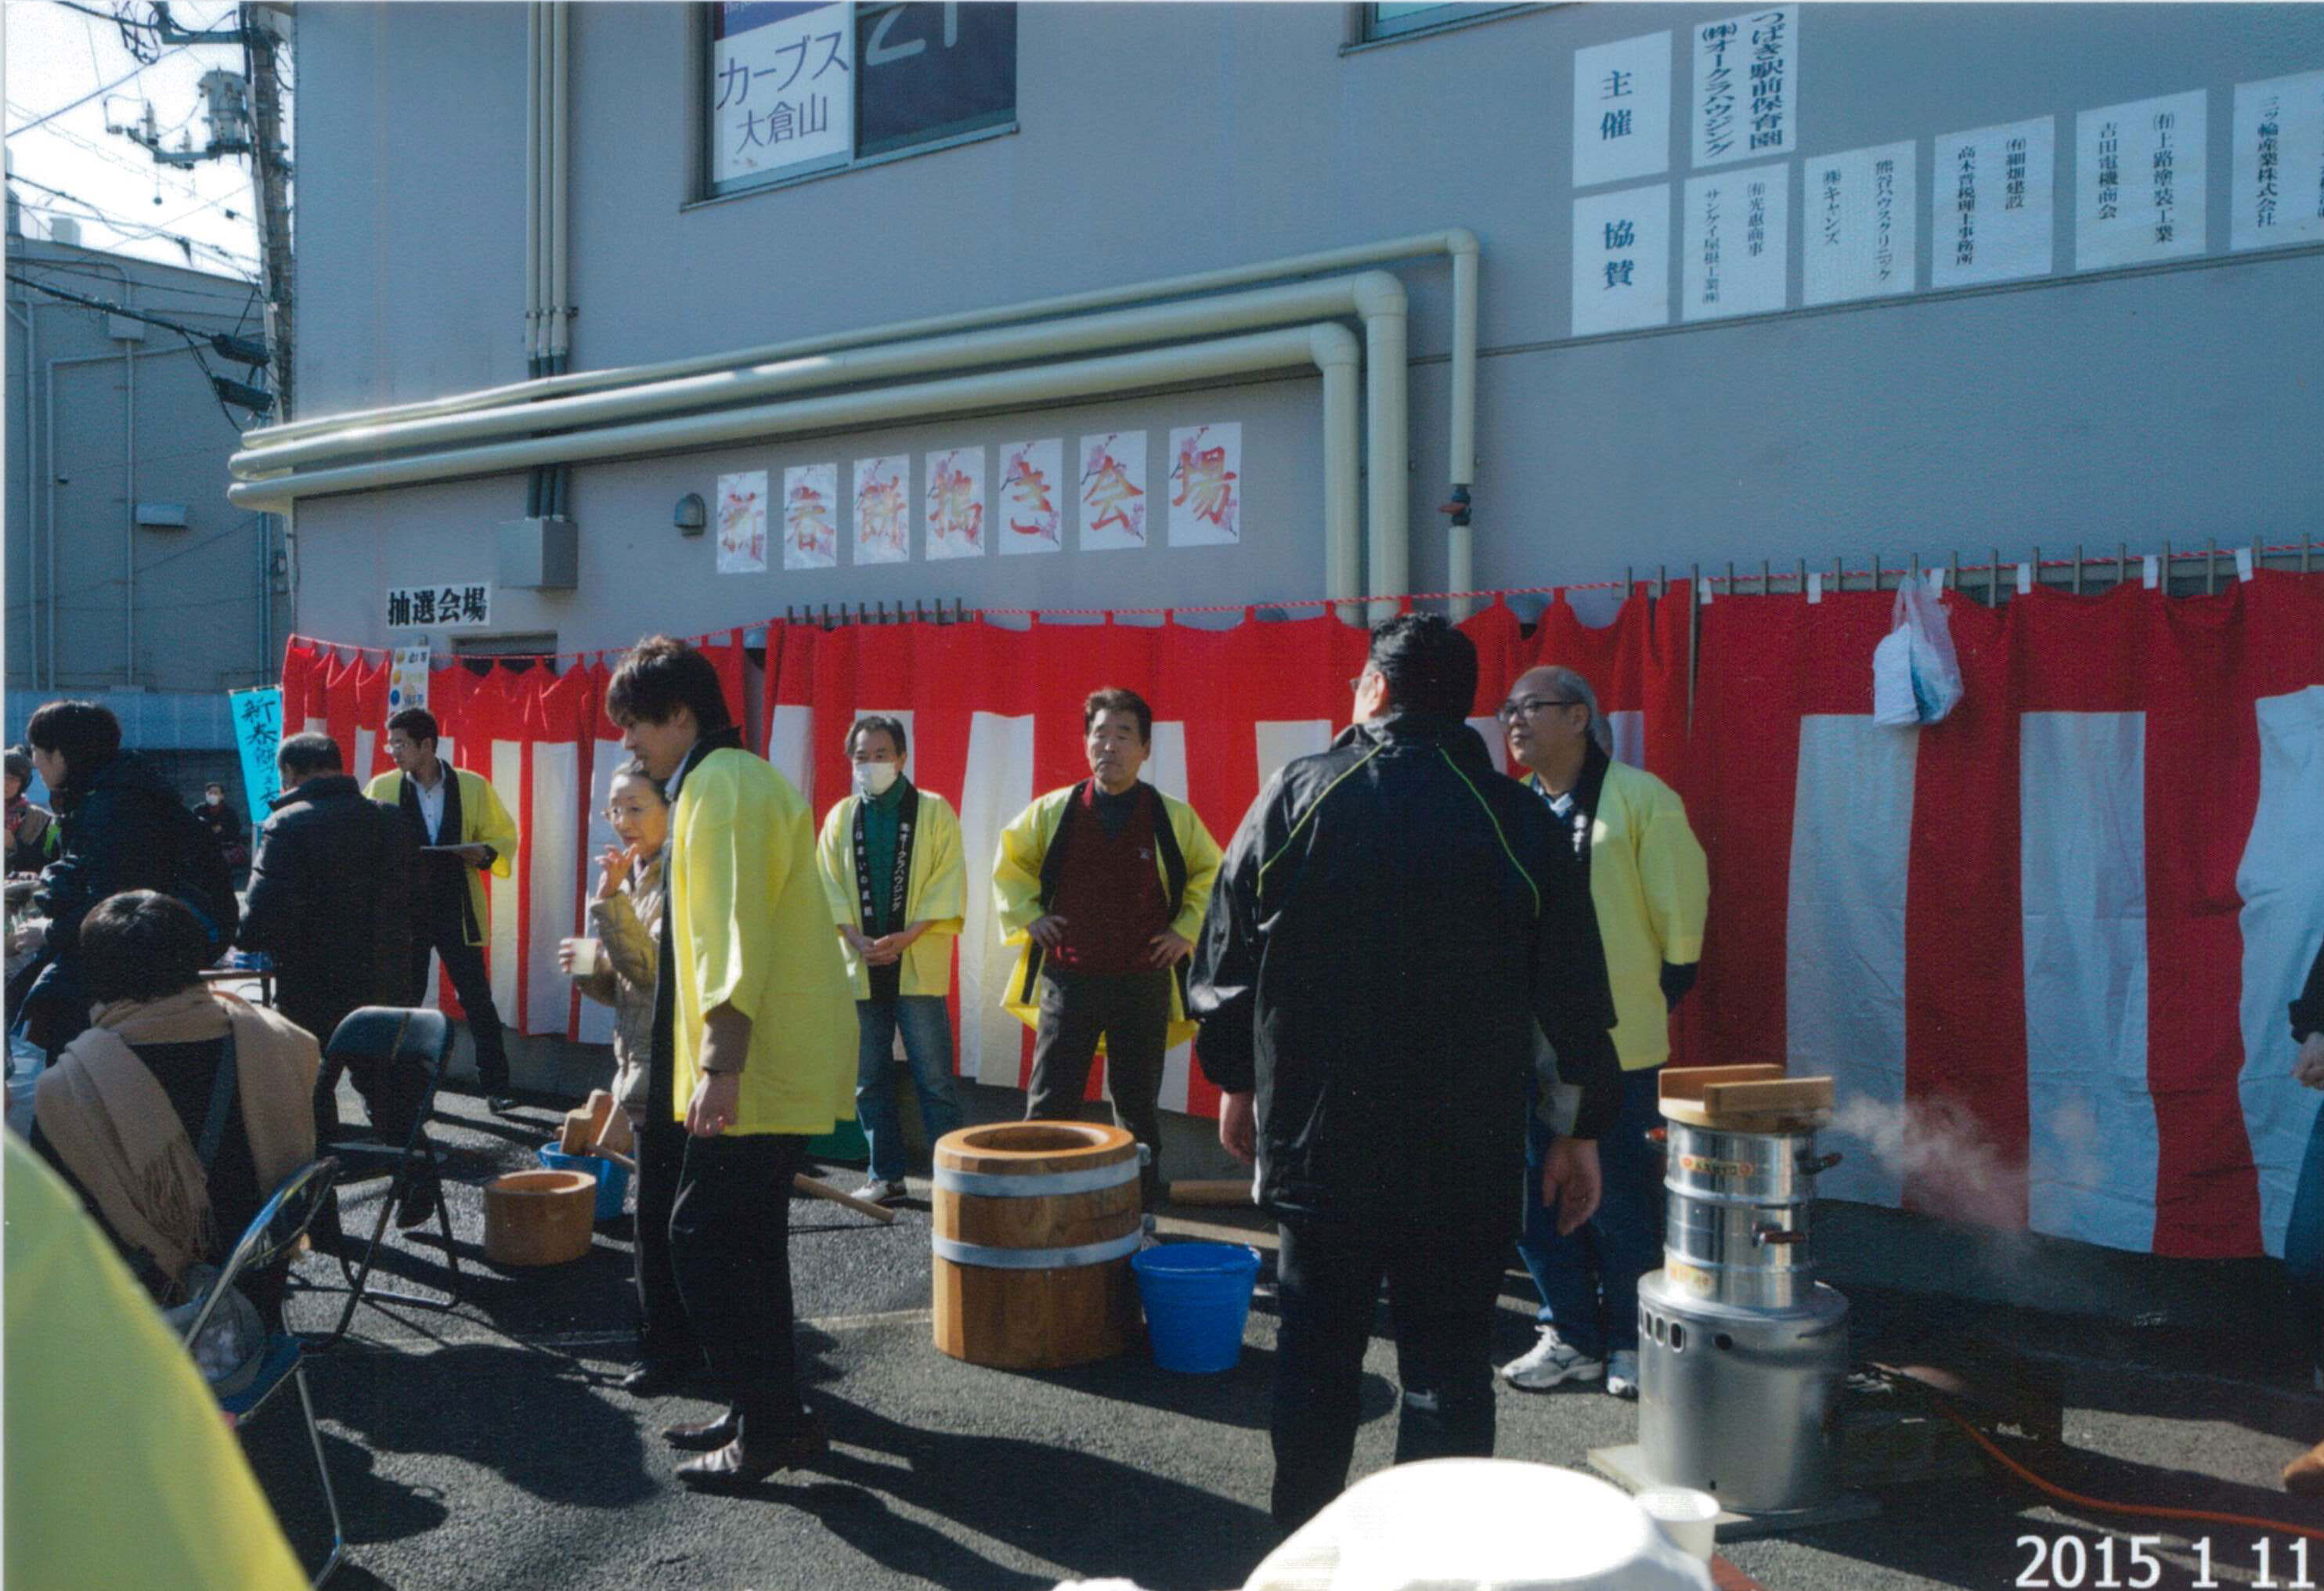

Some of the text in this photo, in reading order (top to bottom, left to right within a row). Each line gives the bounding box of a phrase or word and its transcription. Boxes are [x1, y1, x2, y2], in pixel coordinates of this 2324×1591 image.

[716, 31, 850, 111] カーブス
[1600, 70, 1633, 141] 主催
[1750, 12, 1785, 150] つばき駅前保育園
[736, 93, 828, 154] 大倉山
[1602, 218, 1636, 290] 協賛
[388, 586, 487, 626] 抽選会場
